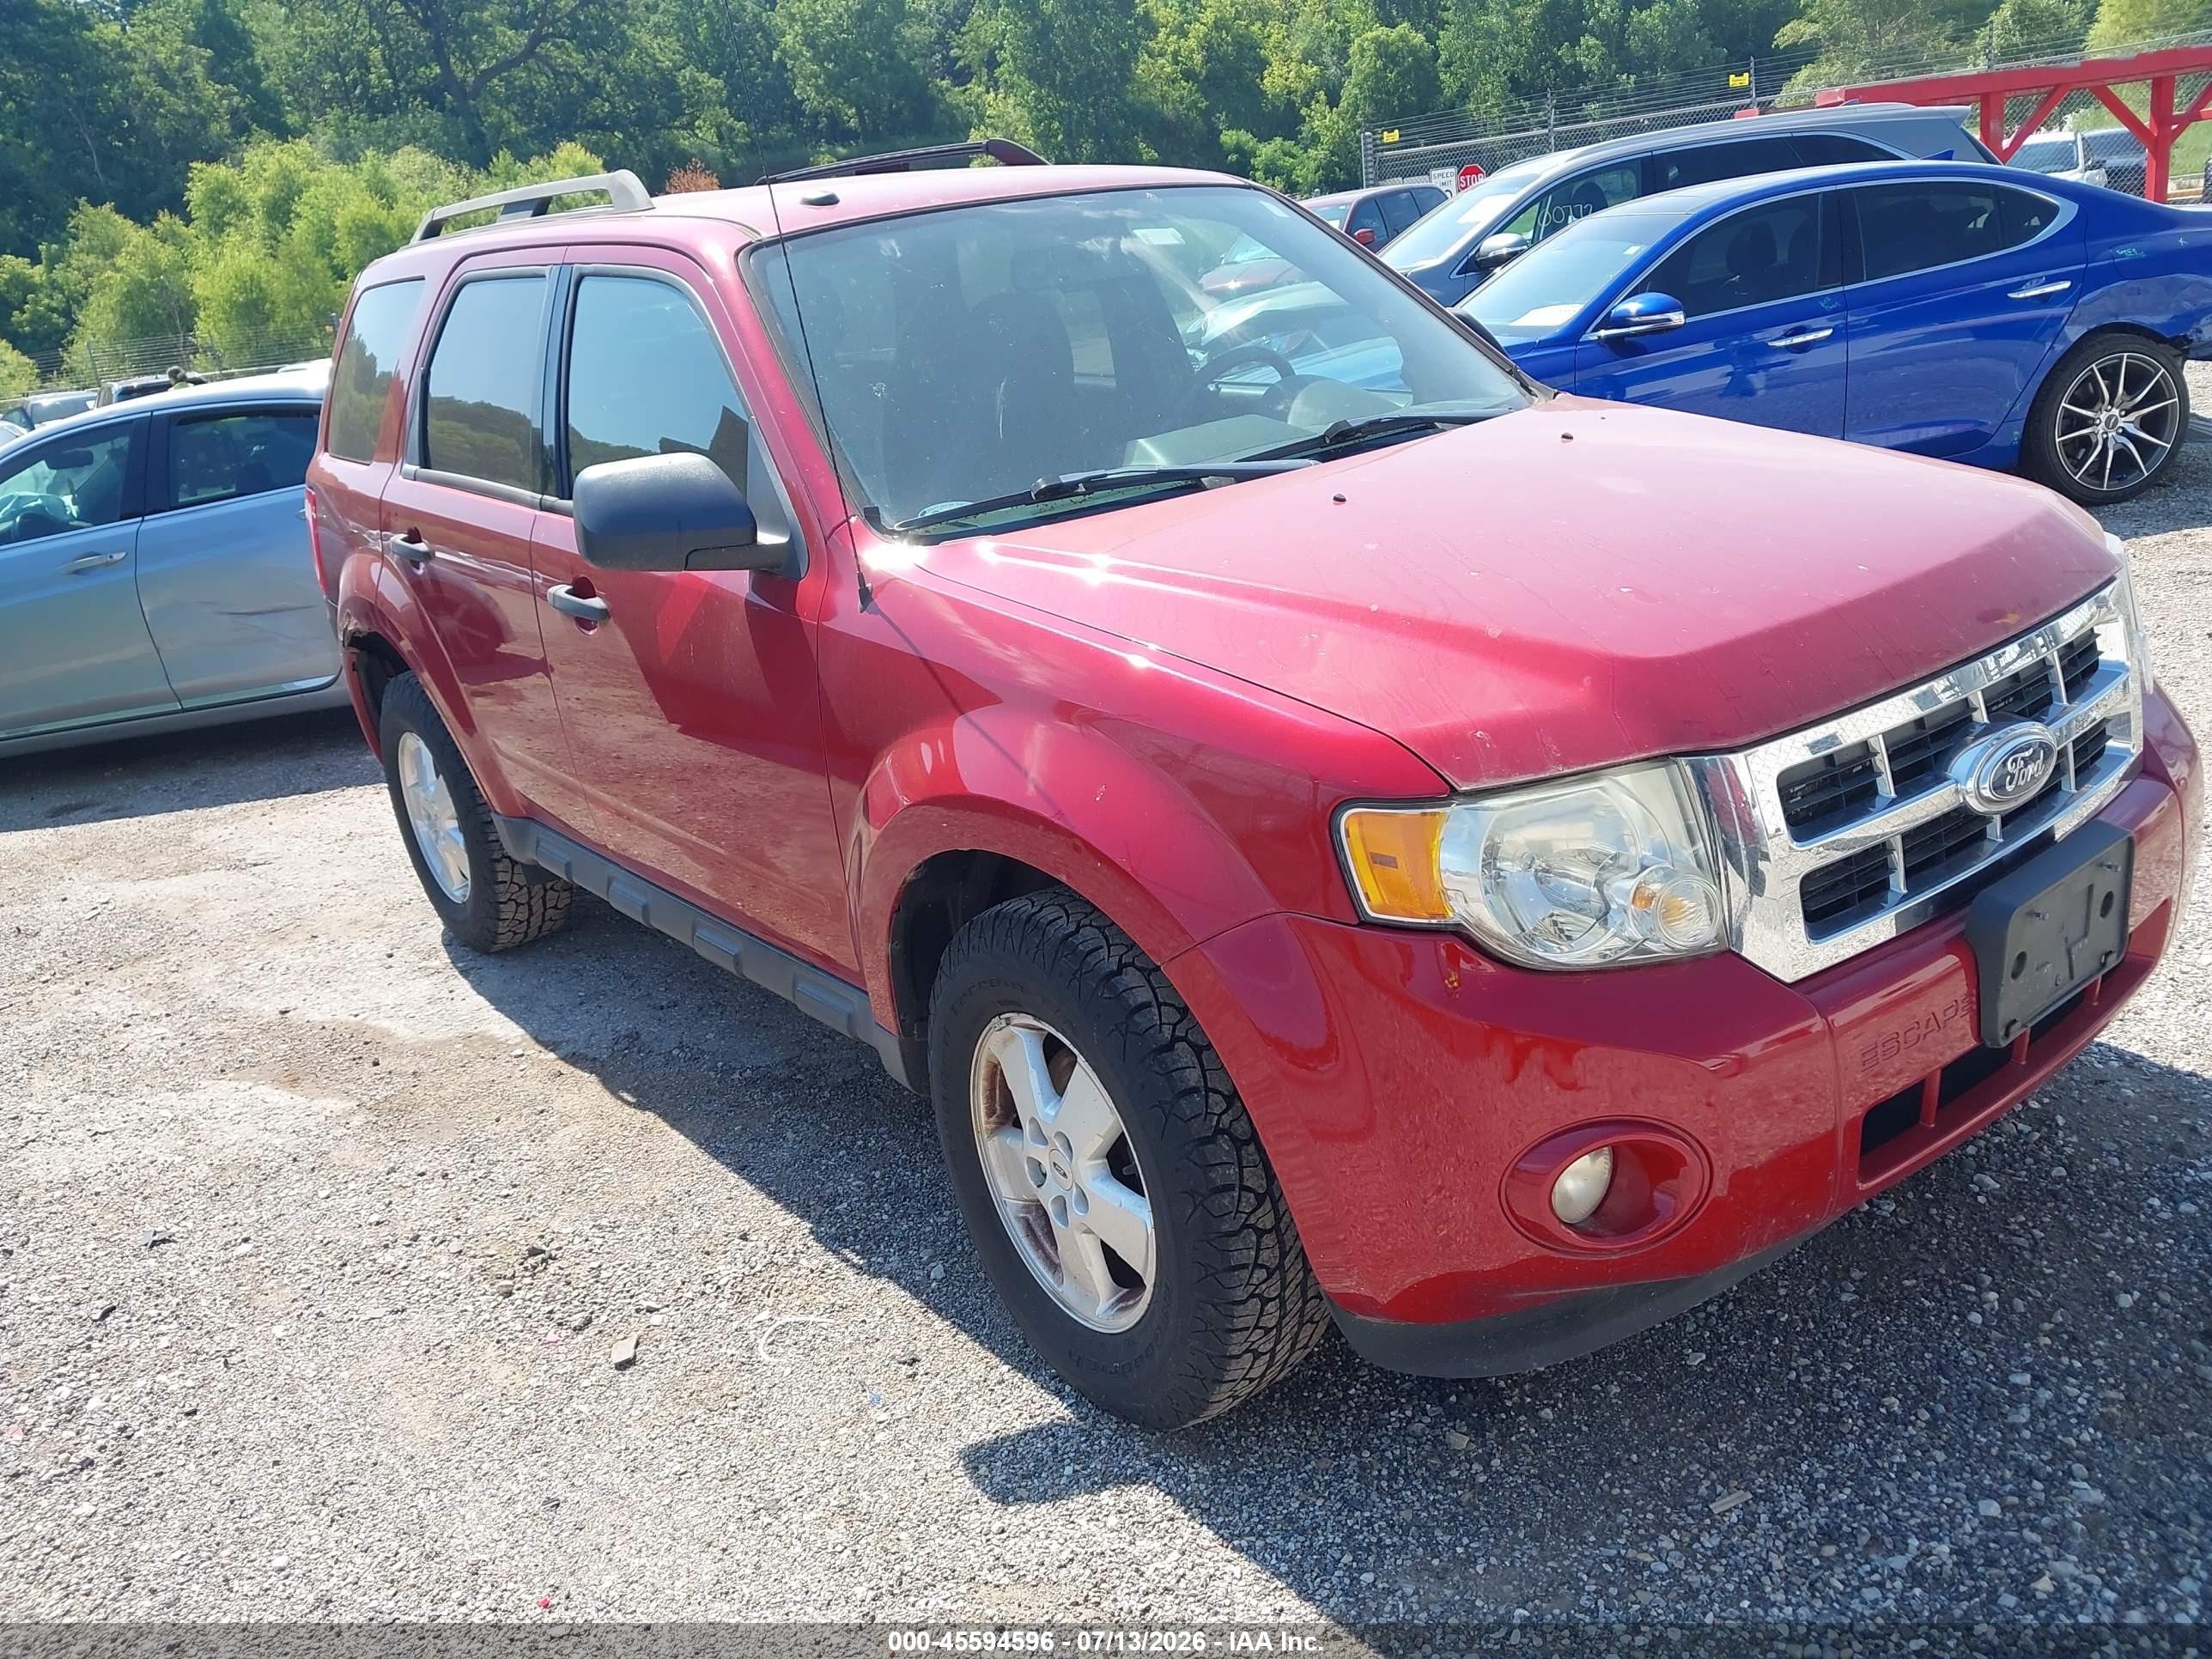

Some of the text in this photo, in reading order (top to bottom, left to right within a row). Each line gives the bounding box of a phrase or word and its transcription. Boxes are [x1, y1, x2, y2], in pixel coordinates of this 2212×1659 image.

[1432, 171, 1454, 179] SPEED
[1460, 173, 1484, 188] STOP
[2005, 747, 2045, 791] Ford
[1860, 996, 1974, 1073] ESCAPE
